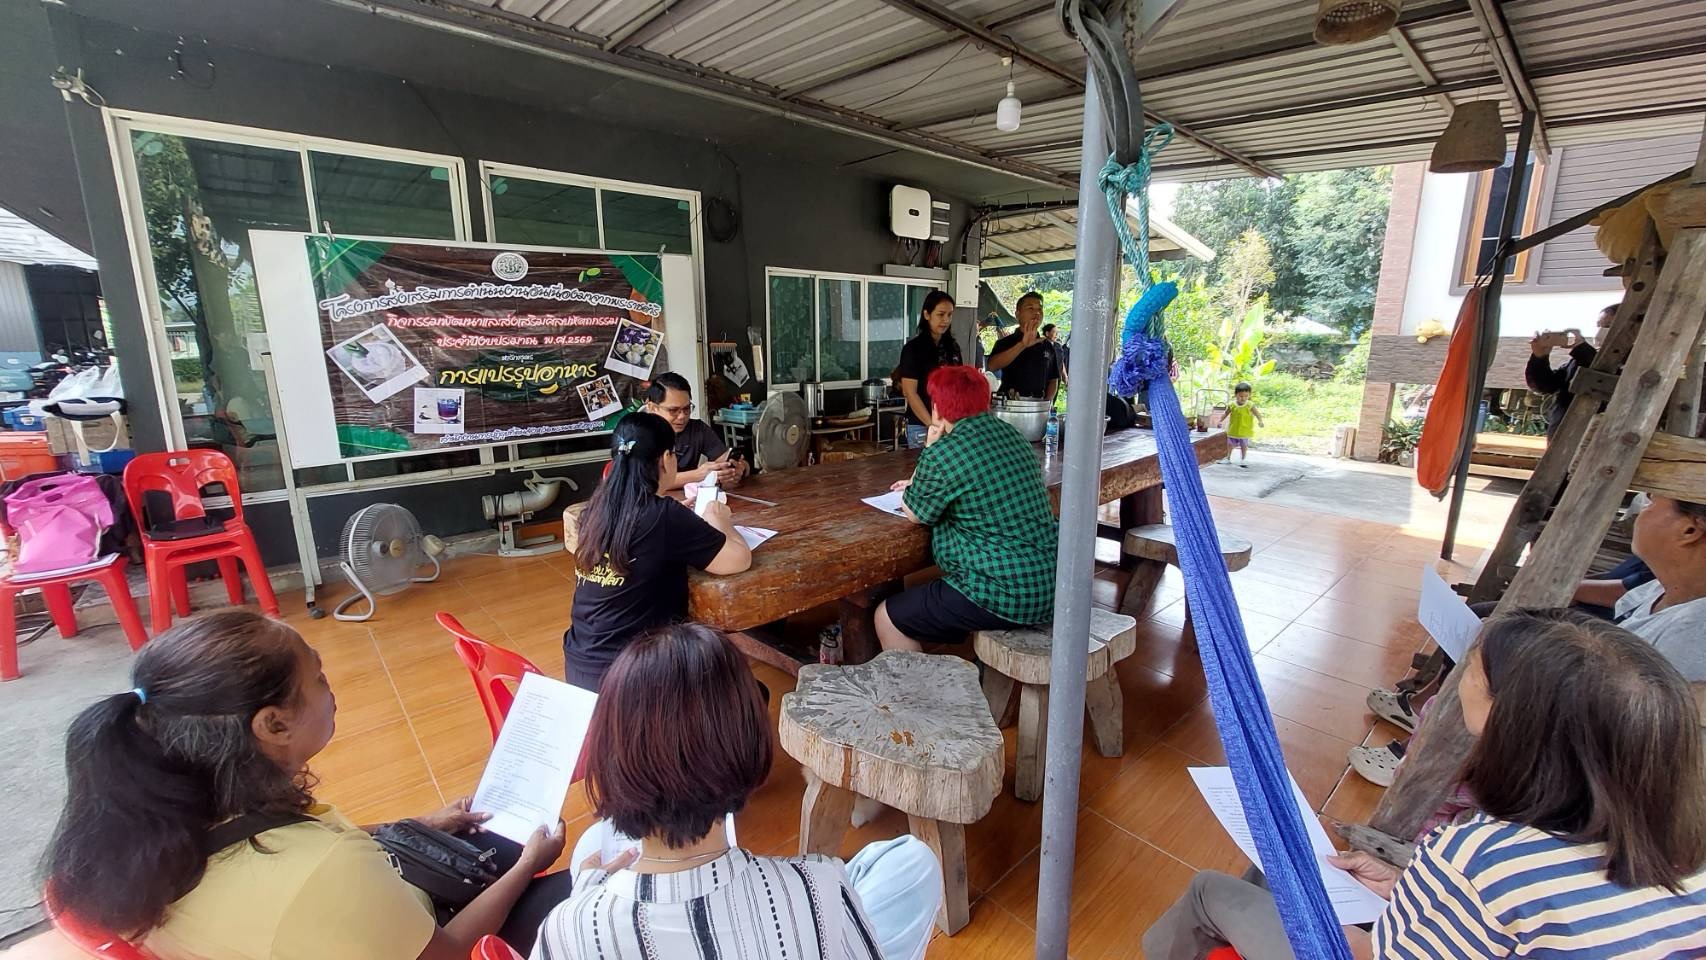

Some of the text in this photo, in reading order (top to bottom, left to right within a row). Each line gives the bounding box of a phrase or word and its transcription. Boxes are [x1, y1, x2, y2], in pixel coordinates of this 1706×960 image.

[439, 362, 598, 389] การแปรรูปอาหาร
